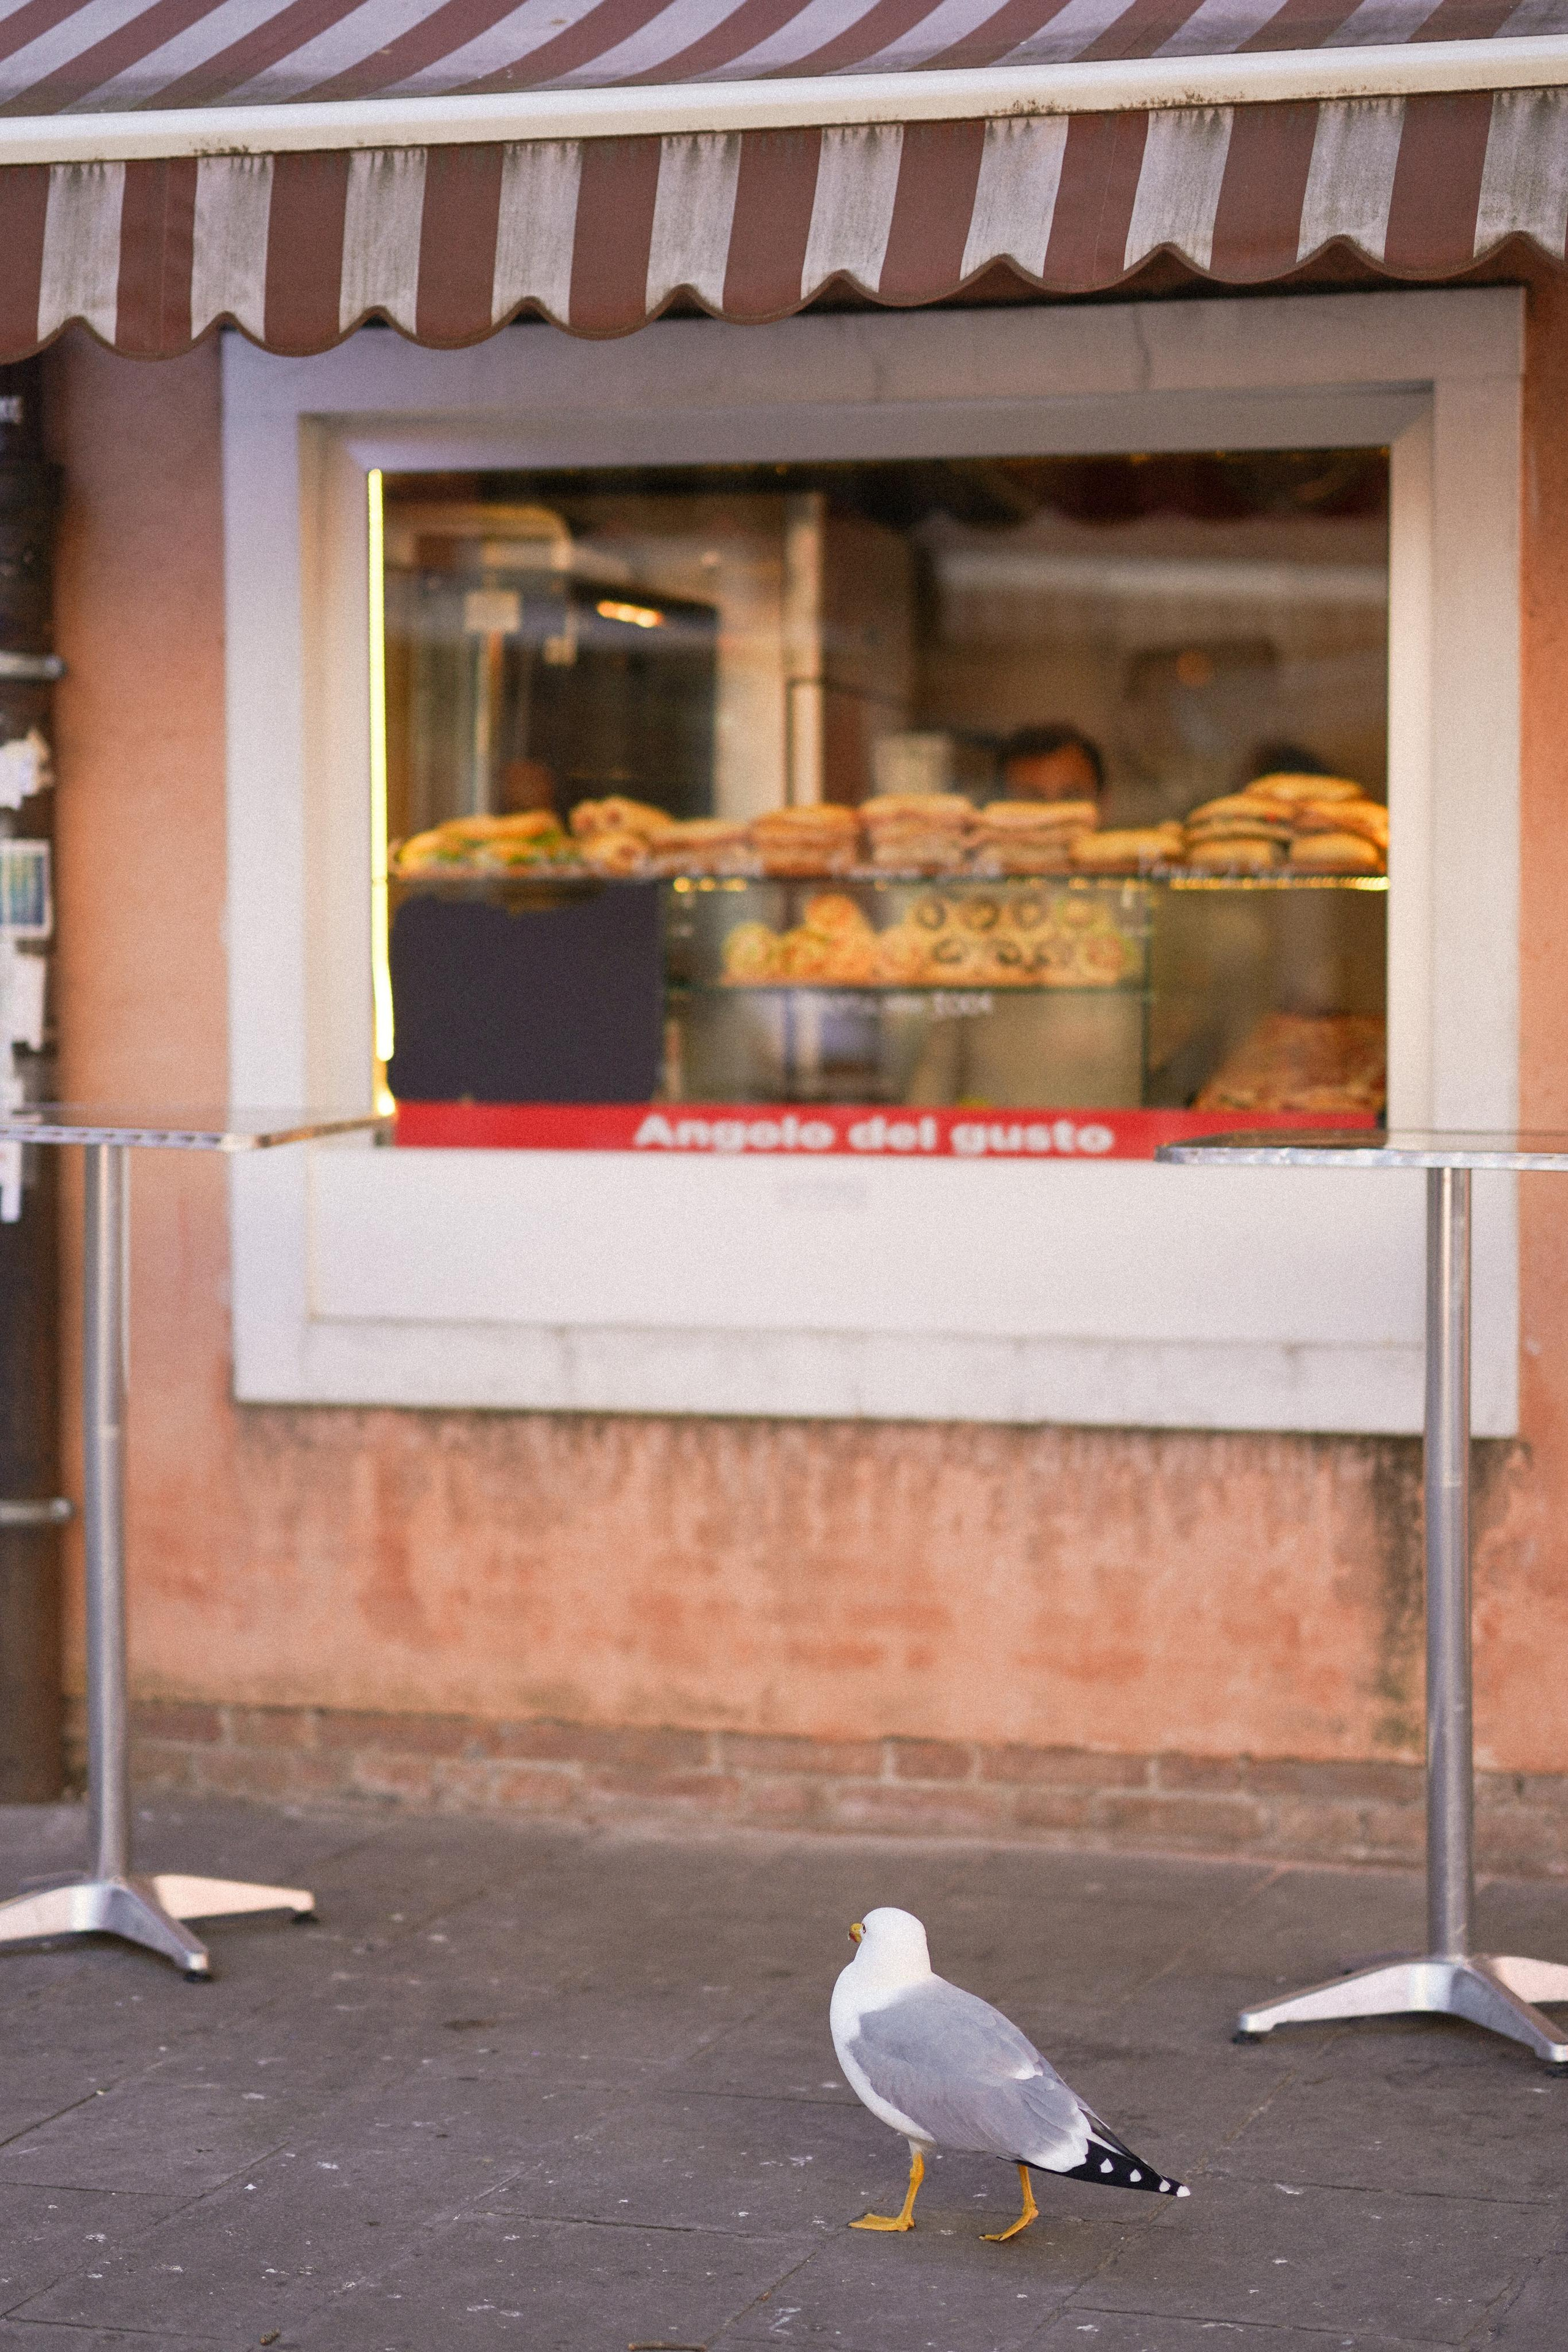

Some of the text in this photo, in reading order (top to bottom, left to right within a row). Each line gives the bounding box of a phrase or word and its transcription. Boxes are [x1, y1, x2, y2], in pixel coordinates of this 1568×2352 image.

[635, 1113, 1115, 1156] Angolo del gusto
